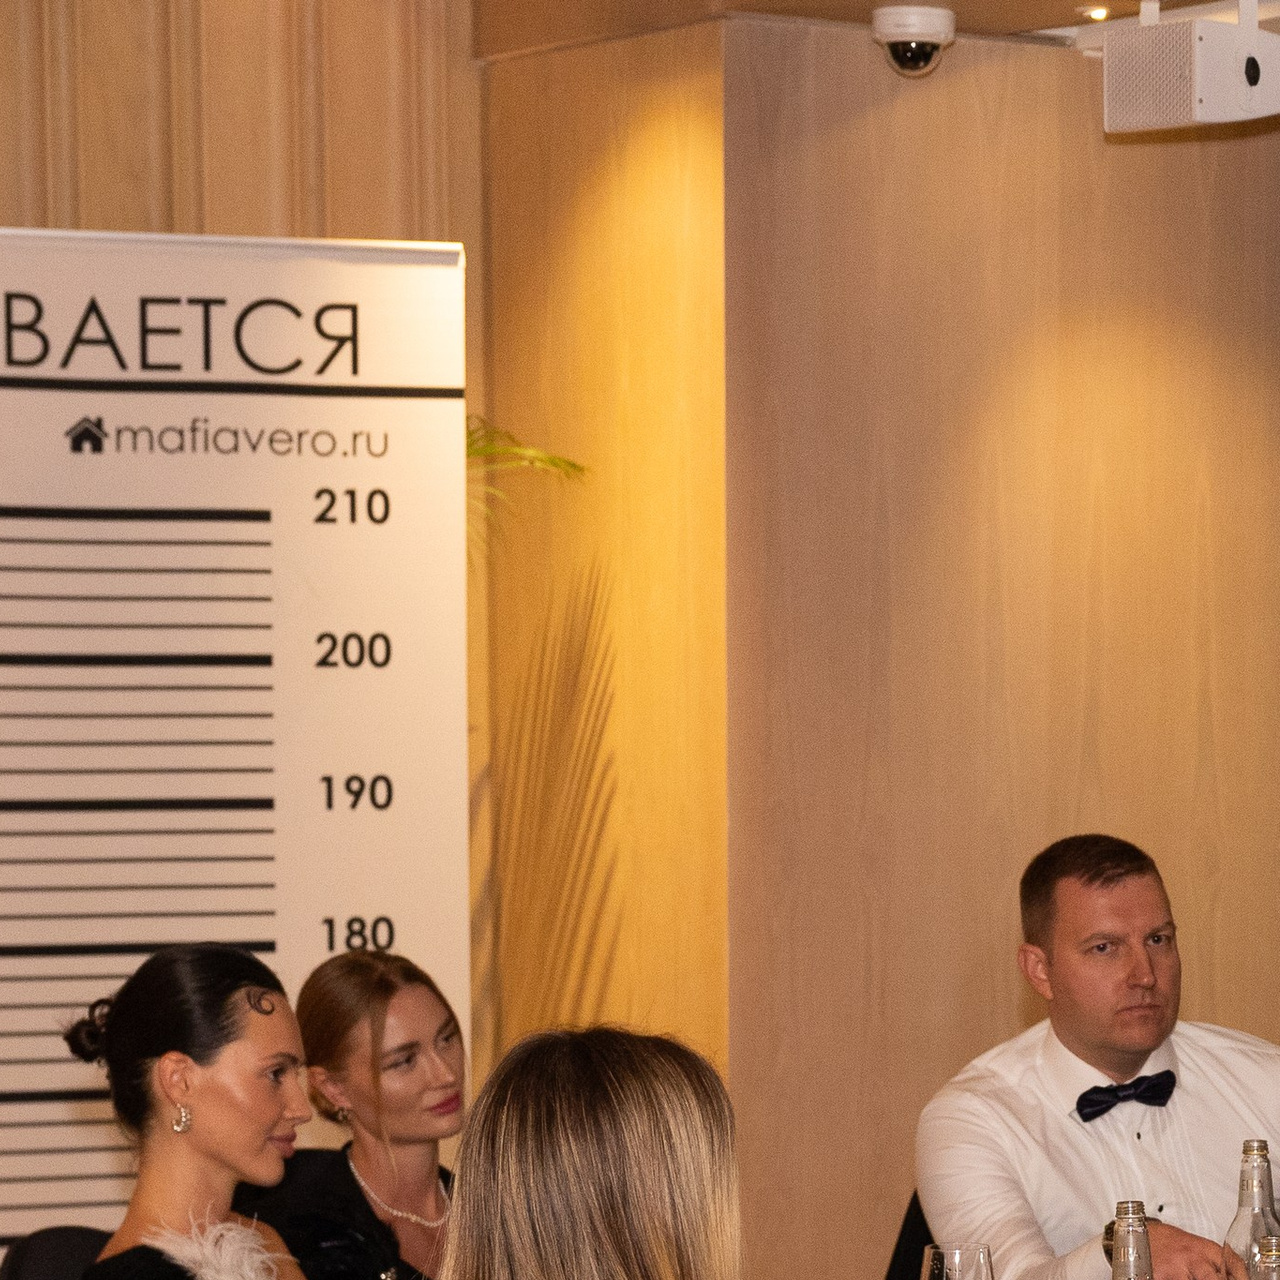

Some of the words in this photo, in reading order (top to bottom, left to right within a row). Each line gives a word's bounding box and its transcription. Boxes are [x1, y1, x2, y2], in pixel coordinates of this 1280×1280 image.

[4, 292, 358, 377] ВАЕТСЯ
[114, 416, 389, 458] mafiavero.ru
[313, 488, 390, 524] 210
[314, 632, 391, 668] 200
[320, 775, 393, 811] 190
[322, 916, 394, 952] 180
